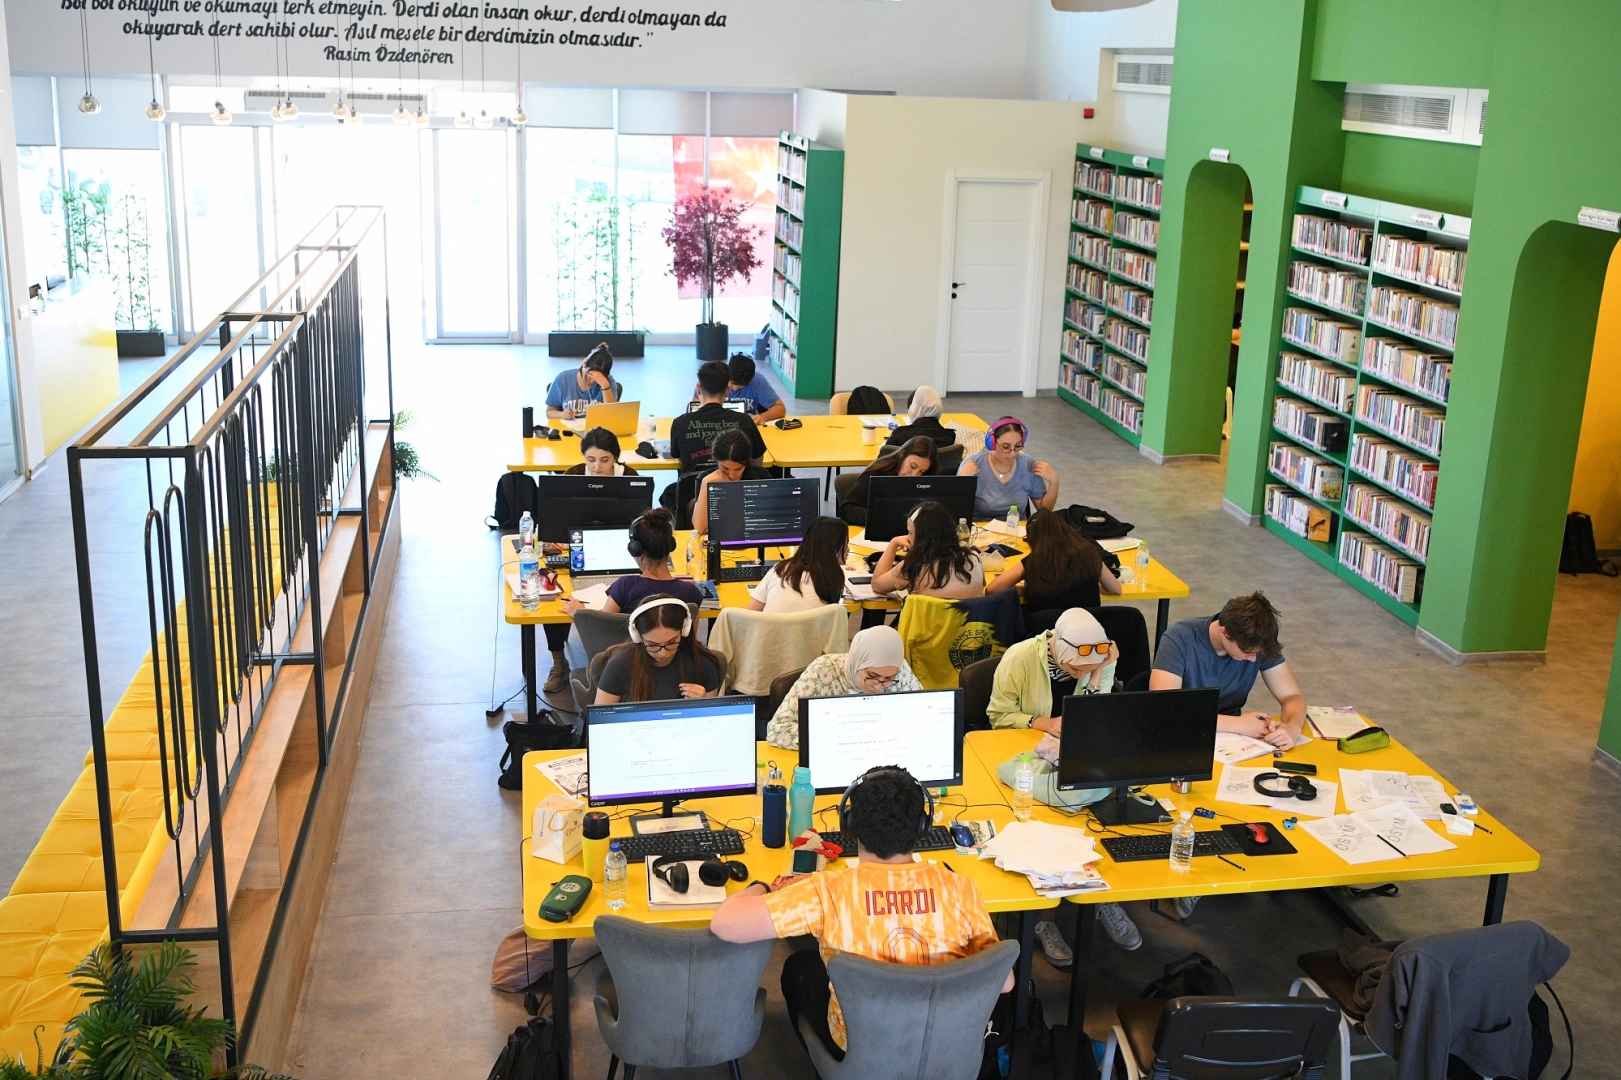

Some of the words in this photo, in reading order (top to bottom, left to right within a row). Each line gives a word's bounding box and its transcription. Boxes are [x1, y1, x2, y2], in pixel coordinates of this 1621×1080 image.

[118, 0, 179, 17] okuyun
[183, 0, 200, 12] ve
[204, 0, 278, 19] okumayı
[283, 0, 315, 14] terk
[318, 0, 387, 21] etmeyin.
[392, 0, 439, 18] Derdi
[442, 3, 479, 18] olan
[483, 2, 529, 20] insan
[534, 5, 576, 23] okur,
[580, 6, 625, 24] derdi
[628, 9, 701, 31] olmayan
[704, 11, 727, 27] da
[122, 19, 204, 41] okuyarak
[208, 20, 242, 37] dert
[245, 21, 295, 38] sahibi
[298, 22, 338, 38] olur.
[344, 22, 378, 42] Asıl
[380, 25, 436, 41] mesele
[438, 26, 463, 41] bir
[464, 26, 555, 44] derdimizin
[323, 45, 371, 62] Rasim
[375, 43, 454, 64] Özdenören
[685, 430, 701, 439] and
[688, 420, 722, 430] Alluring
[722, 420, 739, 428] beat
[865, 887, 937, 916] ICARDI
